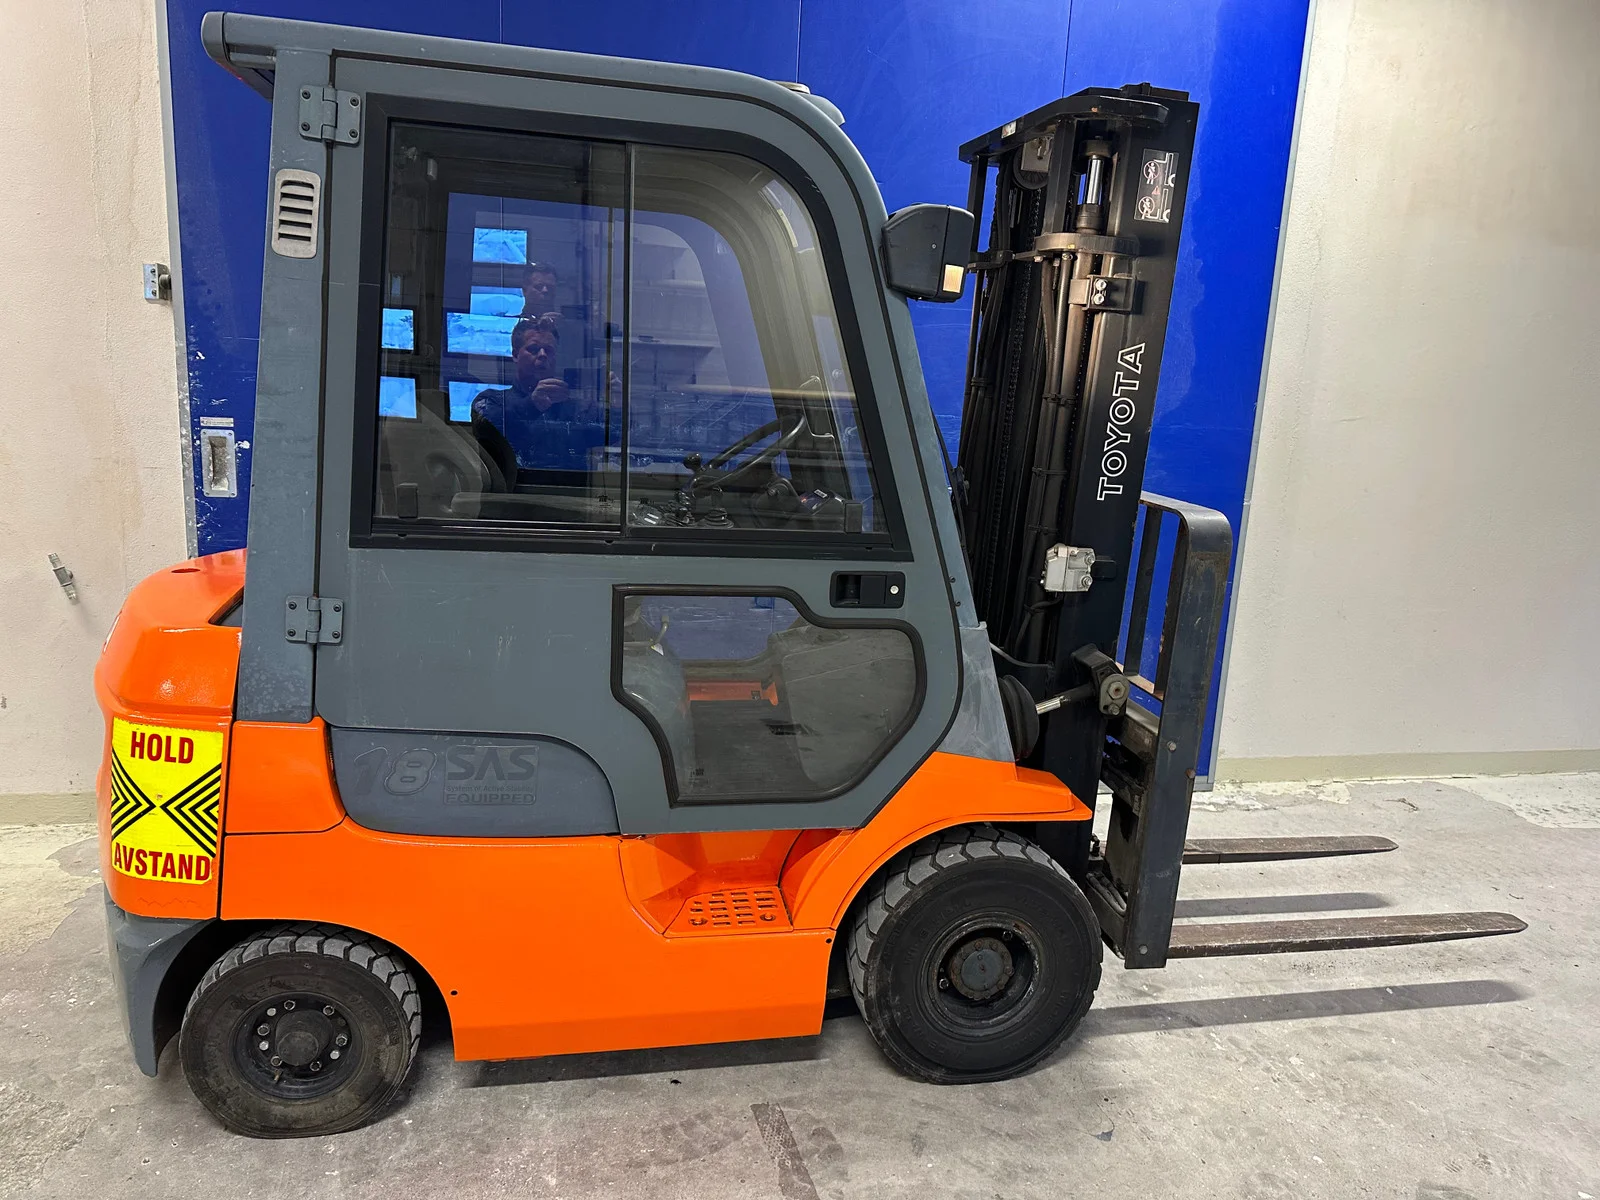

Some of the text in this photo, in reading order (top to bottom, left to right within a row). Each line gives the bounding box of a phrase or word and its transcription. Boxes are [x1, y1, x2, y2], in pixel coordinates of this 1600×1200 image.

[1097, 342, 1146, 501] TOYOTA
[130, 731, 194, 764] HOLD
[447, 746, 536, 780] SAS
[354, 747, 438, 796] 18
[446, 793, 535, 804] EQUIPPED
[114, 842, 211, 881] AVSTAND
